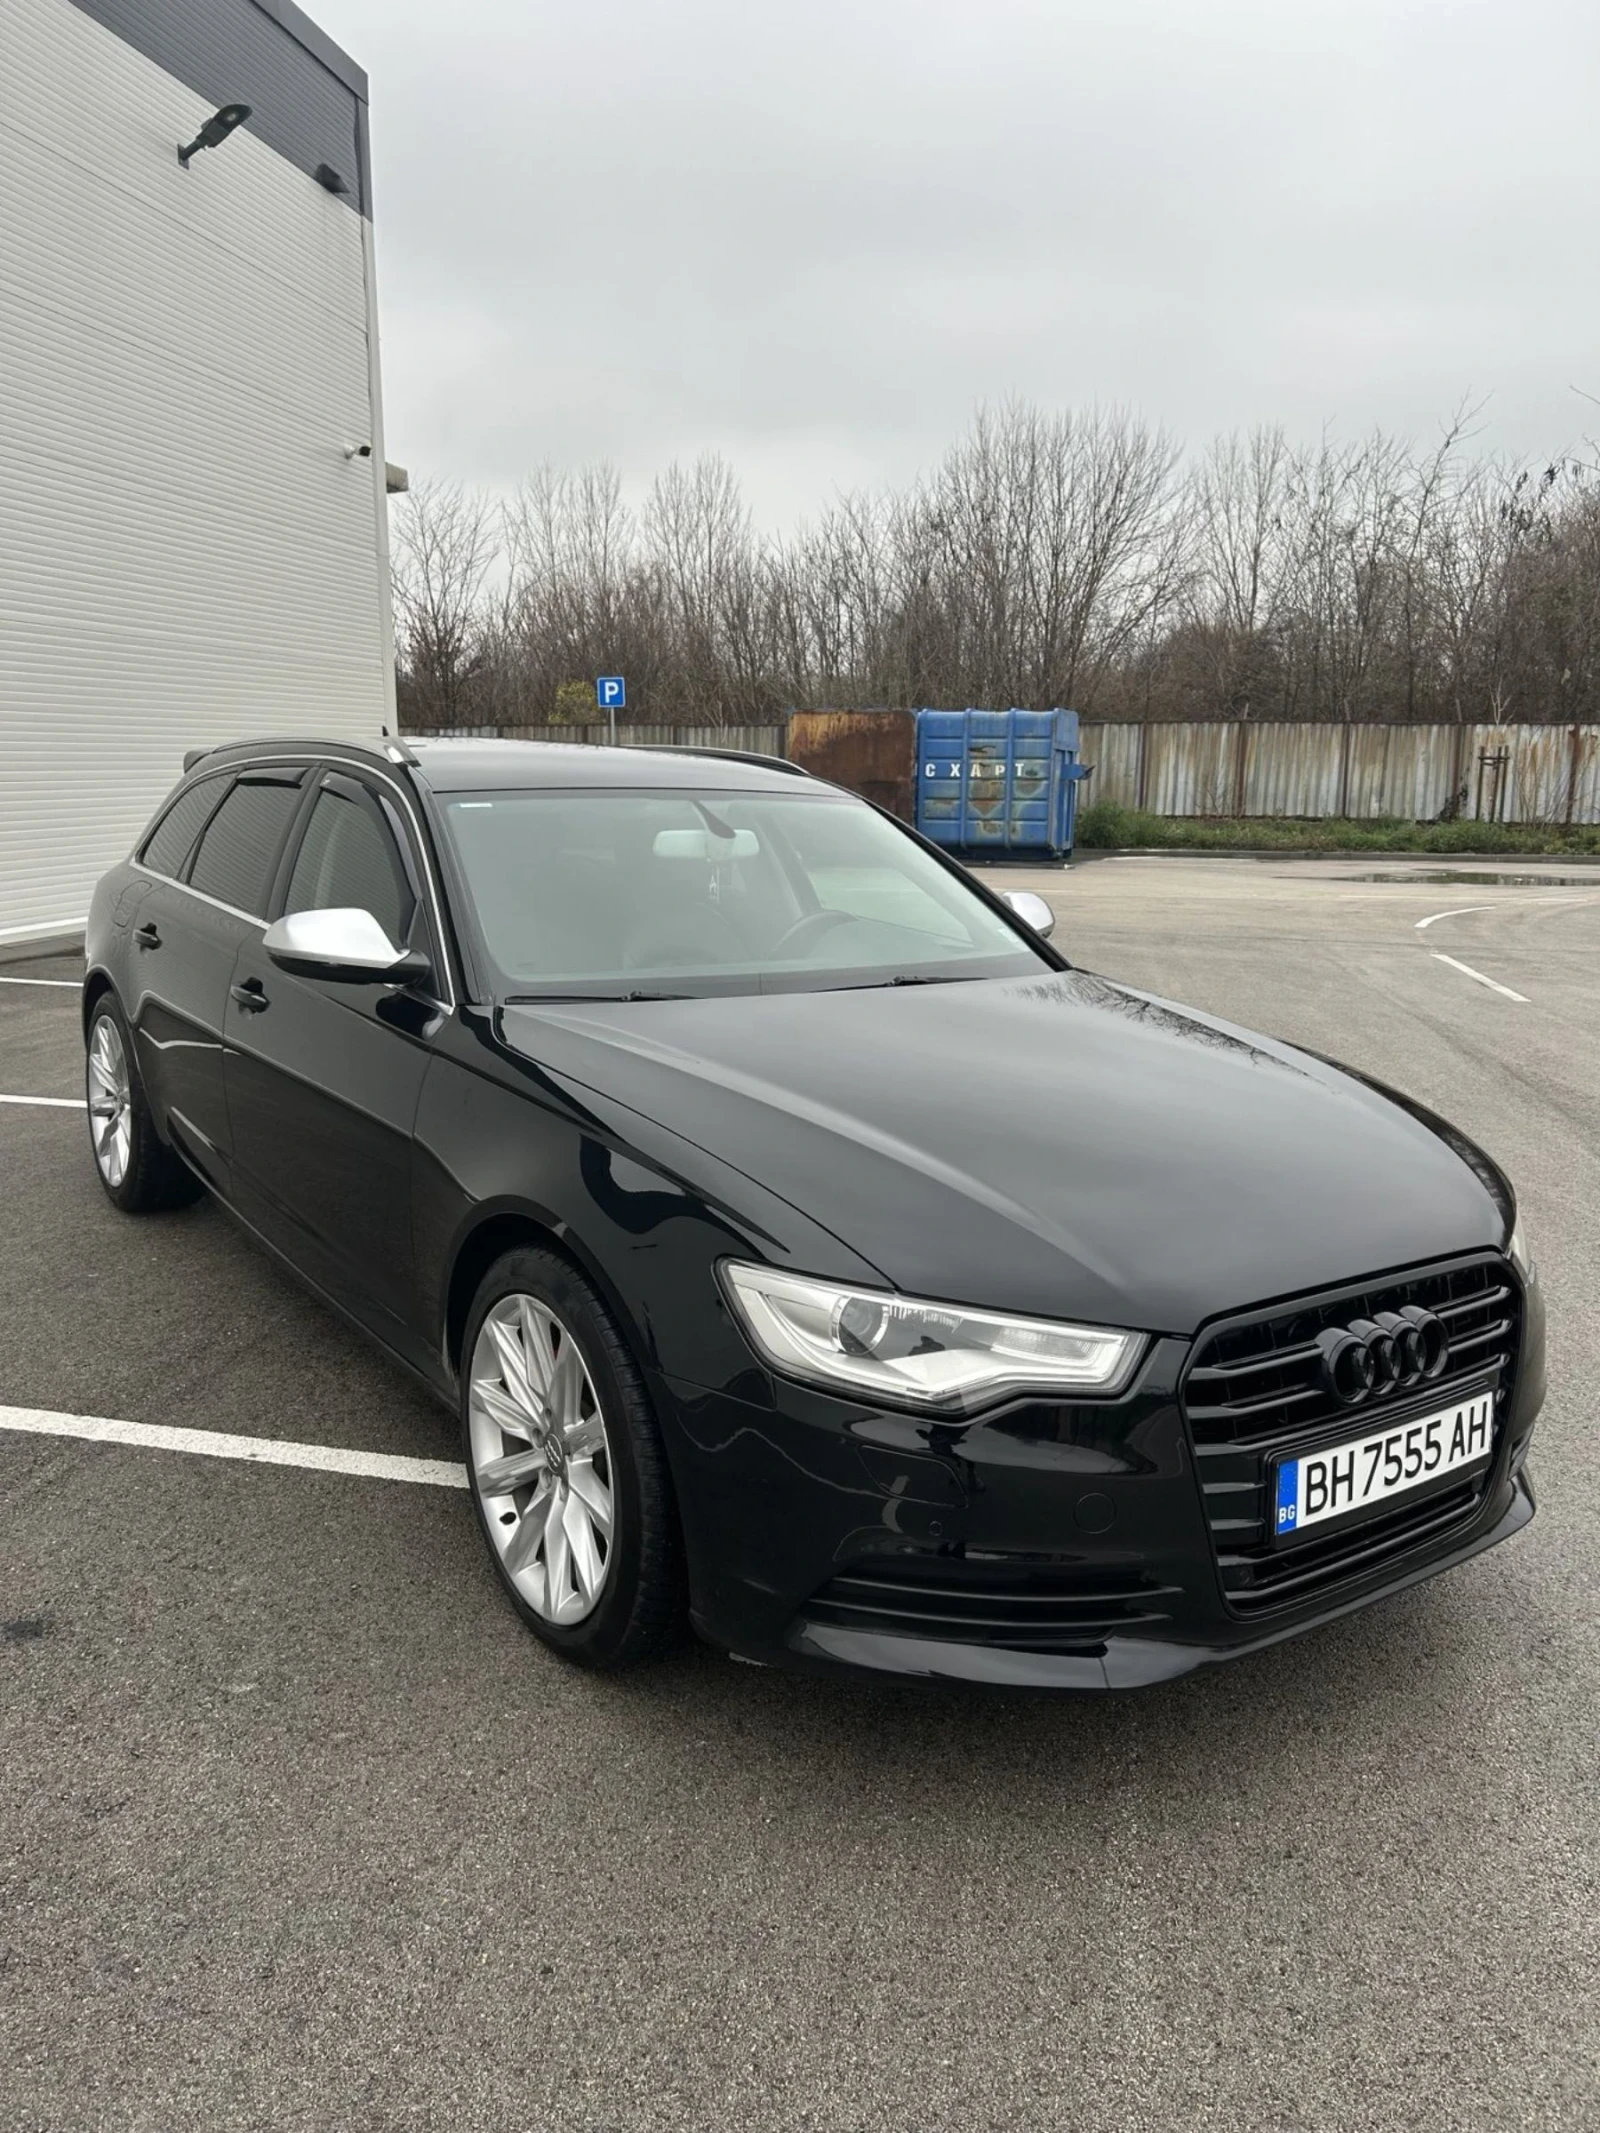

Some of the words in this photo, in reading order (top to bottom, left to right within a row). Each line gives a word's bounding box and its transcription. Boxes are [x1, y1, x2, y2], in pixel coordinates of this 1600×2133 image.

[604, 681, 619, 704] P
[1305, 1450, 1356, 1516] BH
[1362, 1419, 1442, 1497] 7555
[1448, 1401, 1488, 1463] AH
[1279, 1504, 1296, 1524] BG
